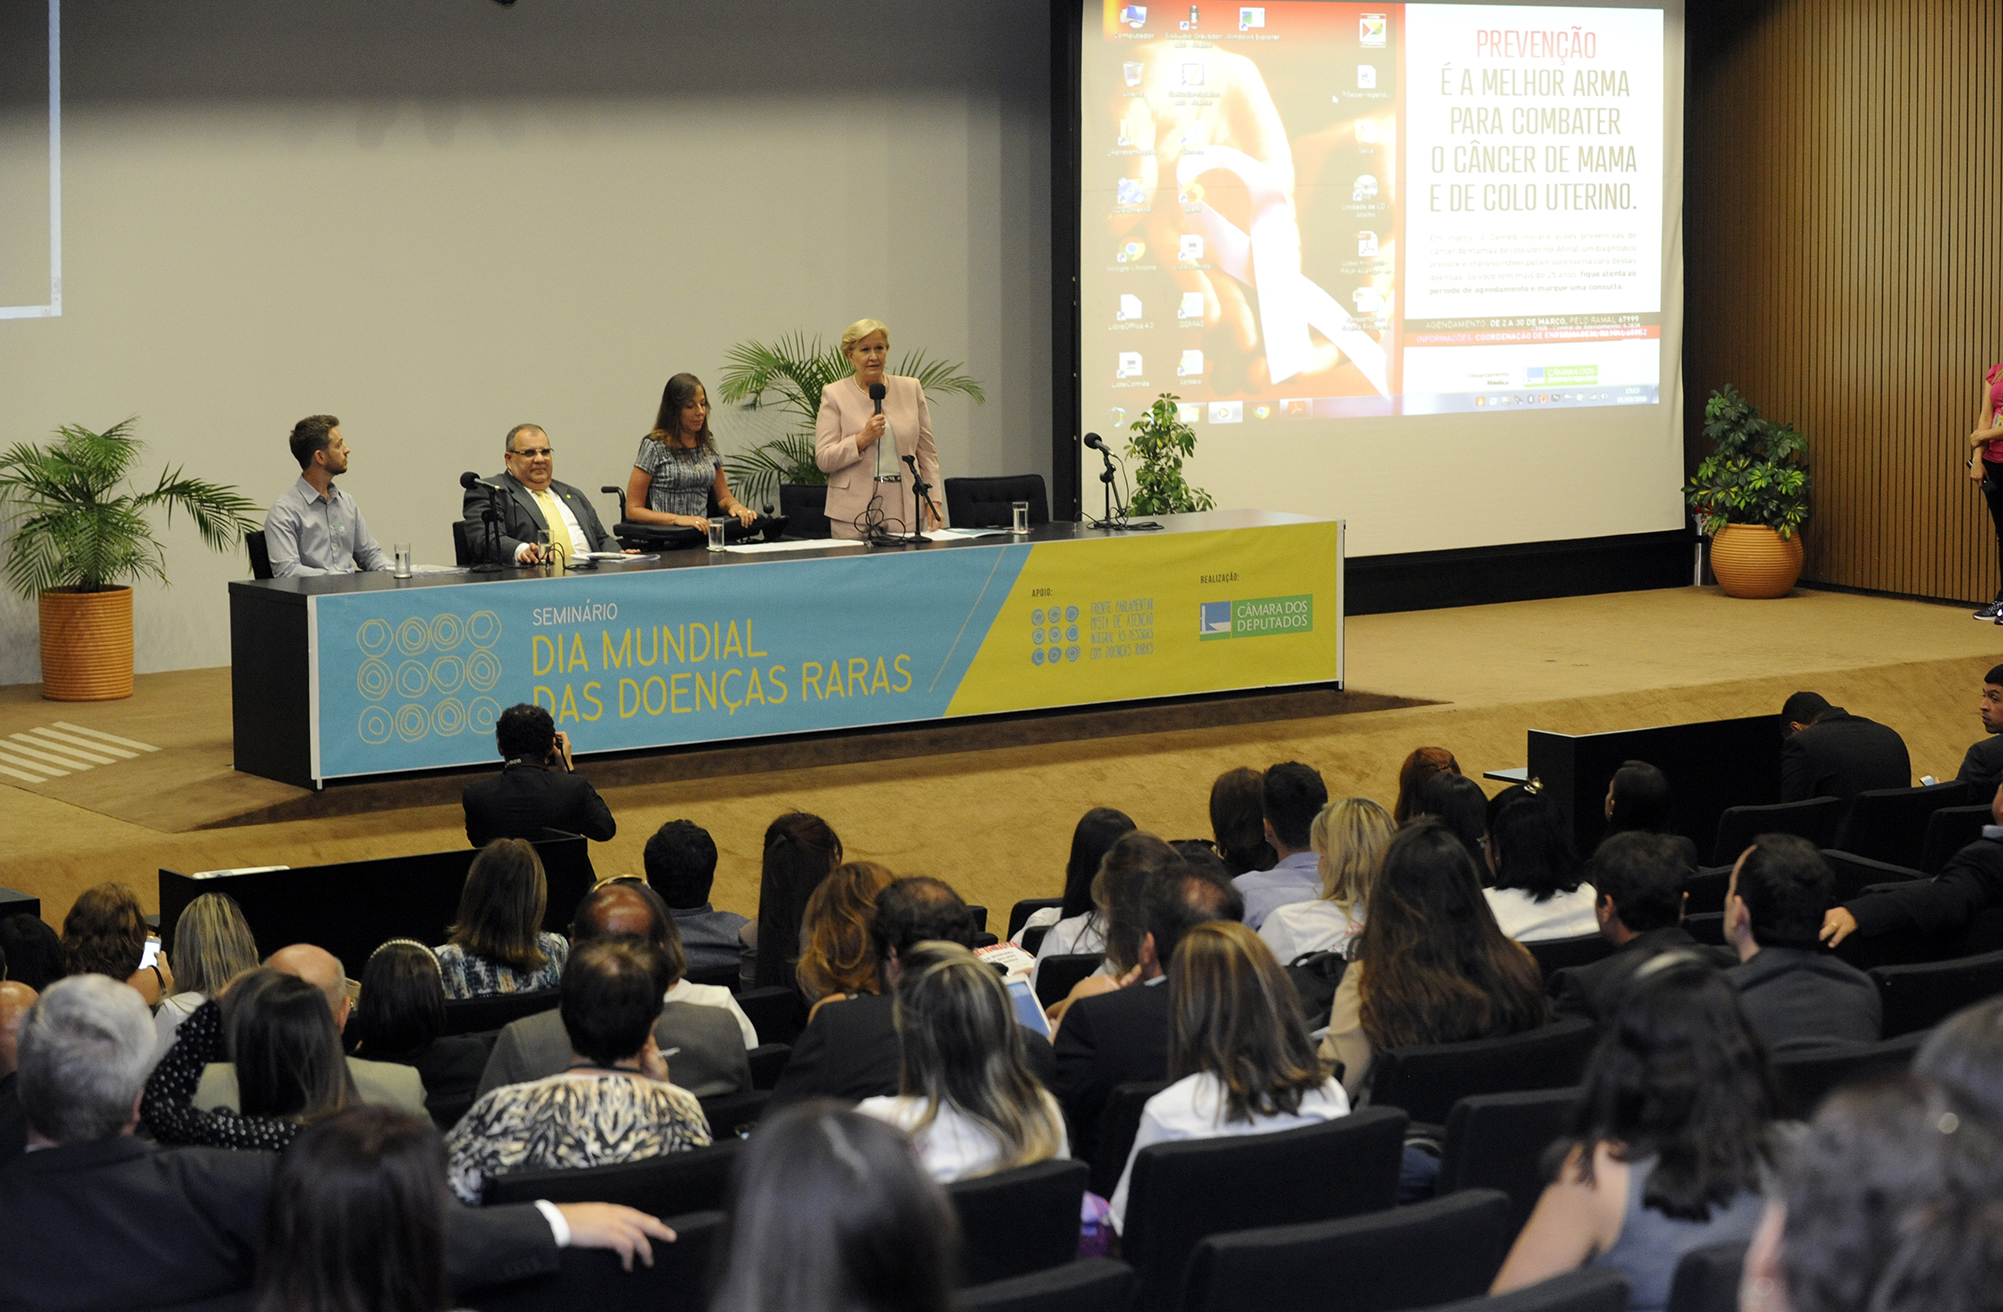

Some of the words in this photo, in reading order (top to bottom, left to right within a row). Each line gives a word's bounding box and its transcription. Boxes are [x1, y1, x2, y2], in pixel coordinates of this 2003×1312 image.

[1477, 26, 1596, 65] PREVENÇÃO
[1441, 62, 1452, 96] É
[1460, 68, 1473, 96] A
[1482, 68, 1565, 96] MELHOR
[1573, 69, 1630, 97] ARMA
[1451, 107, 1503, 135] PARA
[1512, 107, 1621, 135] COMBATER
[1432, 146, 1444, 173] O
[1454, 140, 1536, 173] CÂNCER
[1545, 146, 1570, 173] DE
[1578, 146, 1637, 173] MAMA
[1430, 184, 1441, 212] E
[1450, 184, 1476, 212] DE
[1484, 184, 1537, 212] COLO
[1546, 183, 1638, 211] UTERINO.
[1601, 270, 1626, 278] atenta
[1462, 286, 1472, 294] de
[1474, 285, 1529, 295] agendamento
[1537, 285, 1568, 293] marque
[1490, 319, 1500, 328] DE
[1516, 318, 1525, 327] 30
[1526, 318, 1536, 327] DE
[1569, 316, 1589, 325] PELO
[1590, 315, 1616, 325] RAMAL
[1475, 331, 1531, 342] COORDENAÇÃO
[1533, 331, 1543, 340] DE
[1200, 572, 1240, 584] REALIZAÇÃO:
[1031, 588, 1053, 598] APOIO:
[532, 599, 618, 626] SEMINÁRIO
[1237, 603, 1283, 618] CÂMARA
[1285, 600, 1308, 614] DOS
[1237, 614, 1308, 632] DEPUTADOS
[533, 632, 589, 676] DIA
[603, 619, 768, 670] MUNDIAL
[533, 681, 603, 724] DAS
[619, 665, 788, 718] DOENÇAS
[802, 653, 912, 701] RARAS
